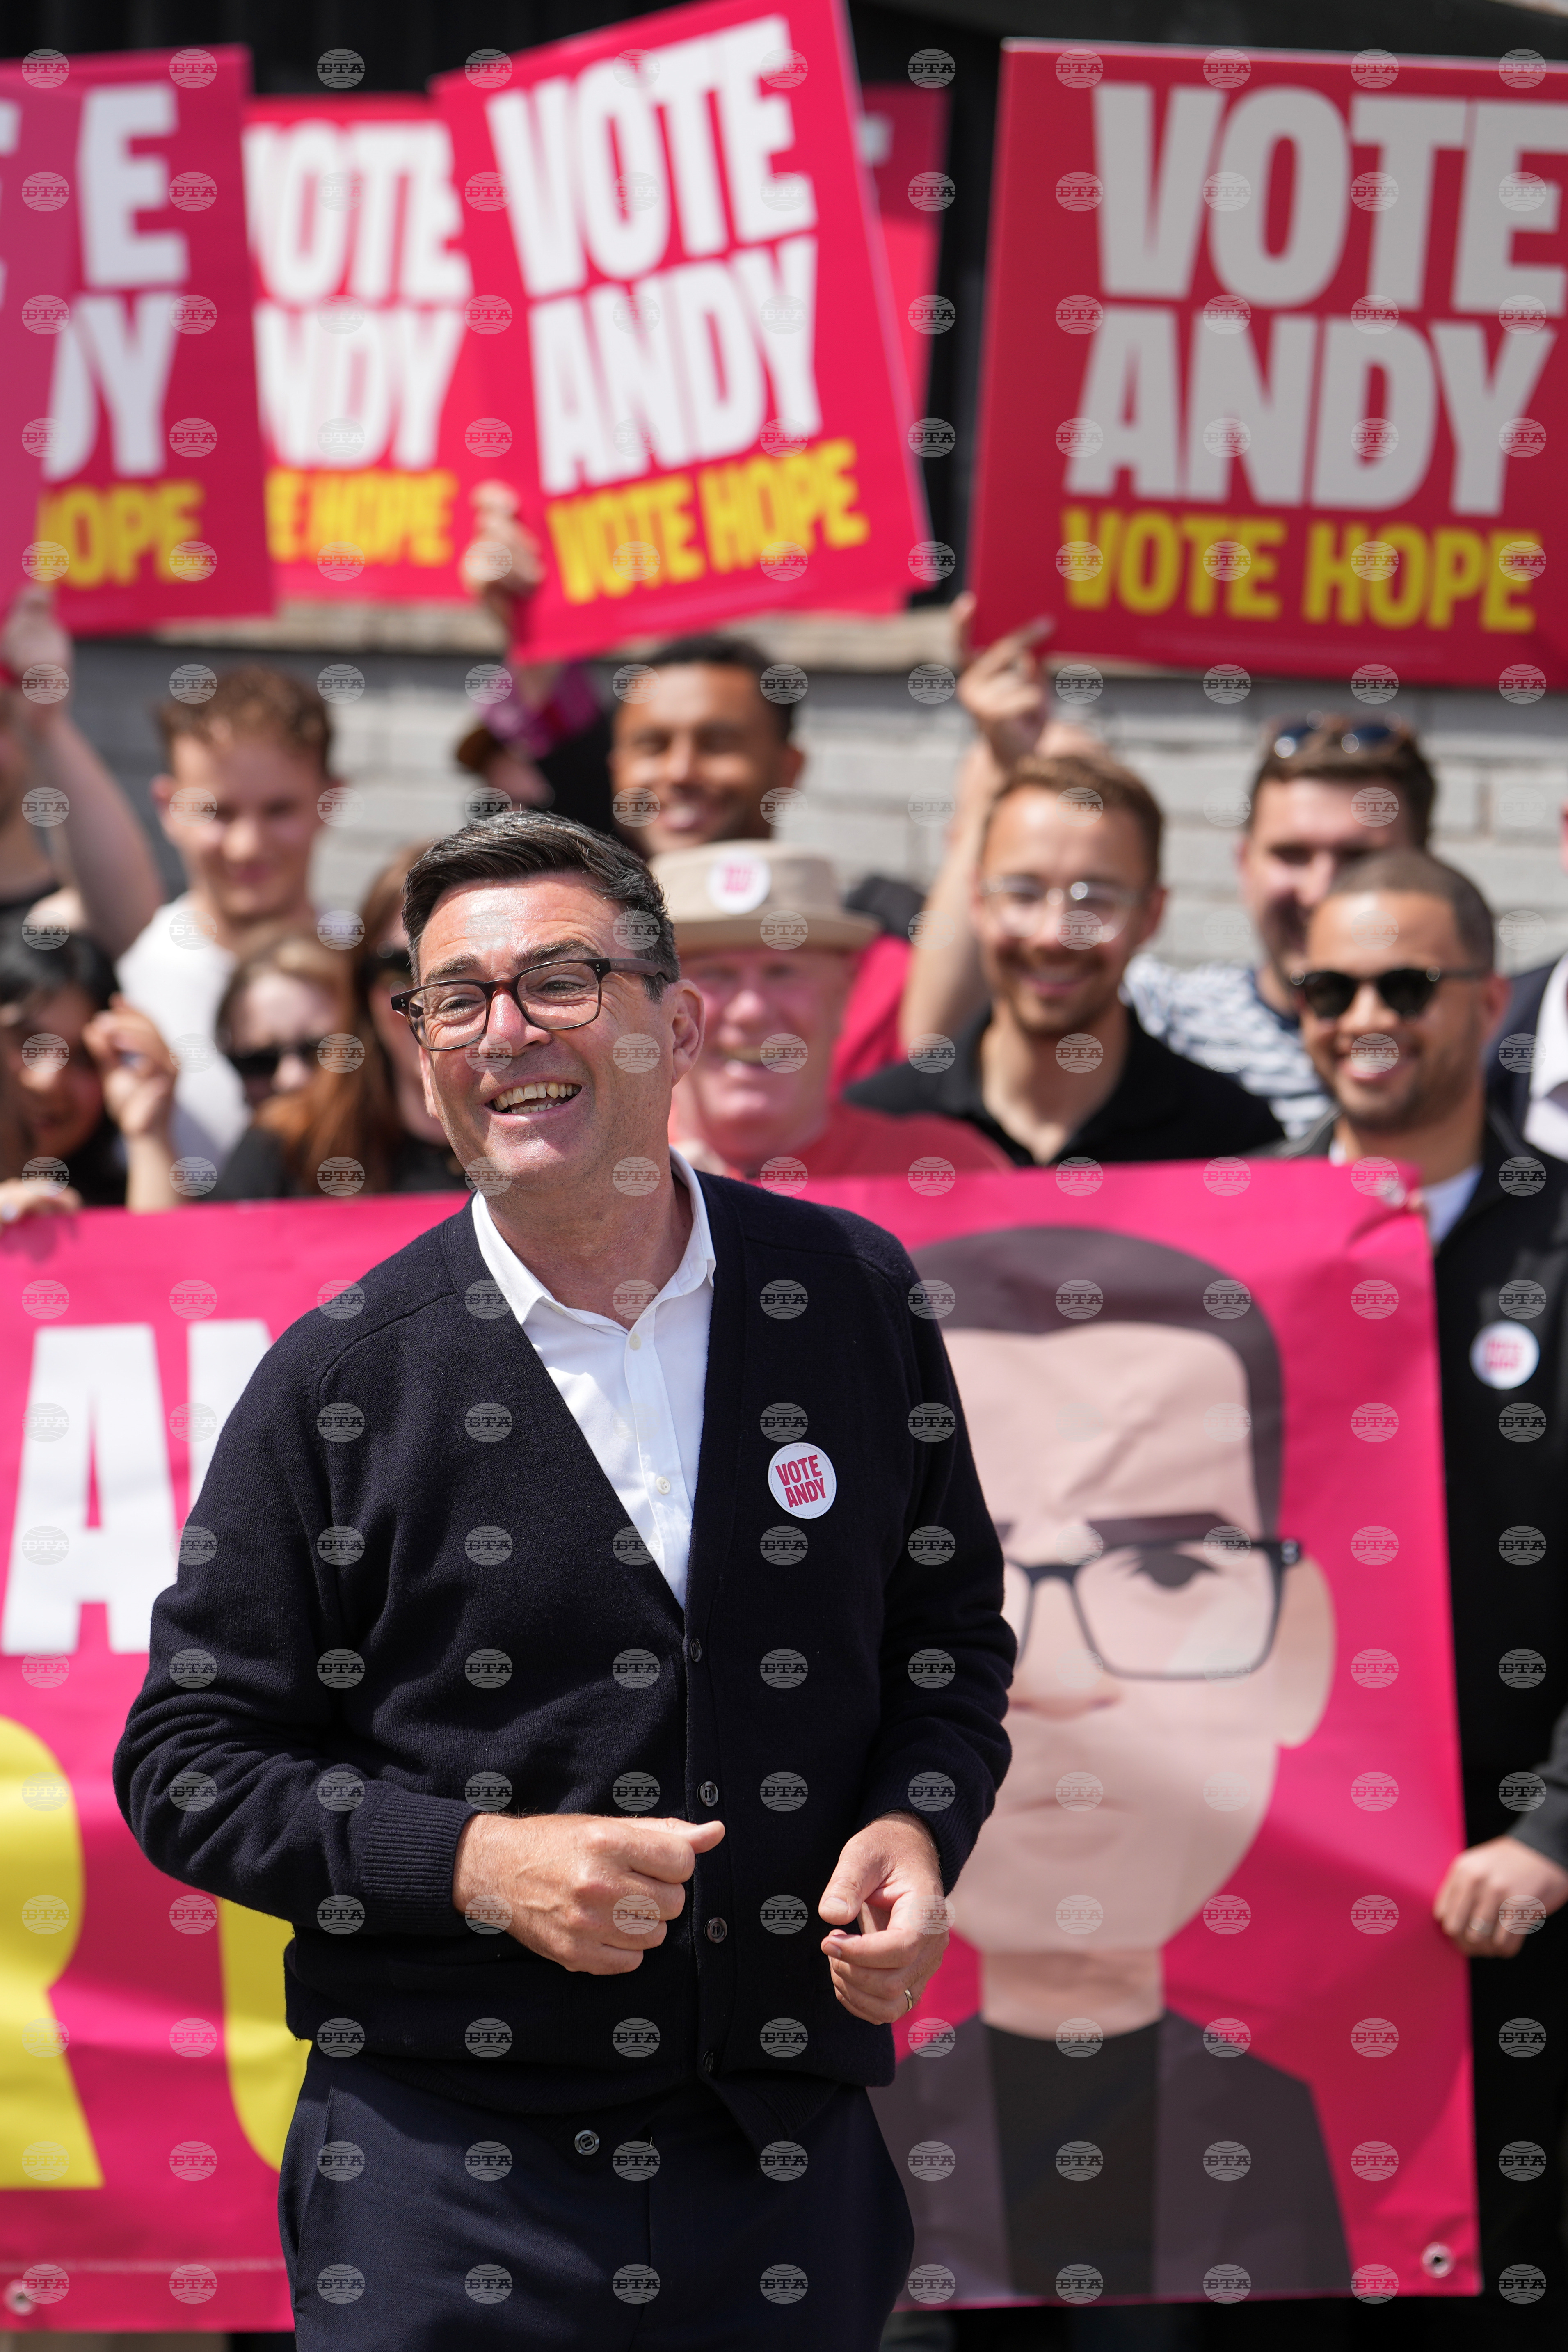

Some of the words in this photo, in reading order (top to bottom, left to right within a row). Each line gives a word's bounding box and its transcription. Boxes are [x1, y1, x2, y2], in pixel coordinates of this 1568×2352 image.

[485, 16, 817, 296] VOTE
[1093, 83, 1568, 317] VOTE
[254, 300, 465, 469] NDY
[528, 237, 821, 492] ANDY
[1065, 306, 1558, 514] ANDY
[548, 474, 704, 604] VOTE
[699, 439, 868, 572] HOPE
[1063, 510, 1285, 619] VOTE
[1305, 522, 1541, 632] HOPE
[775, 1454, 822, 1486] VOTE
[784, 1477, 826, 1508] ANDY
